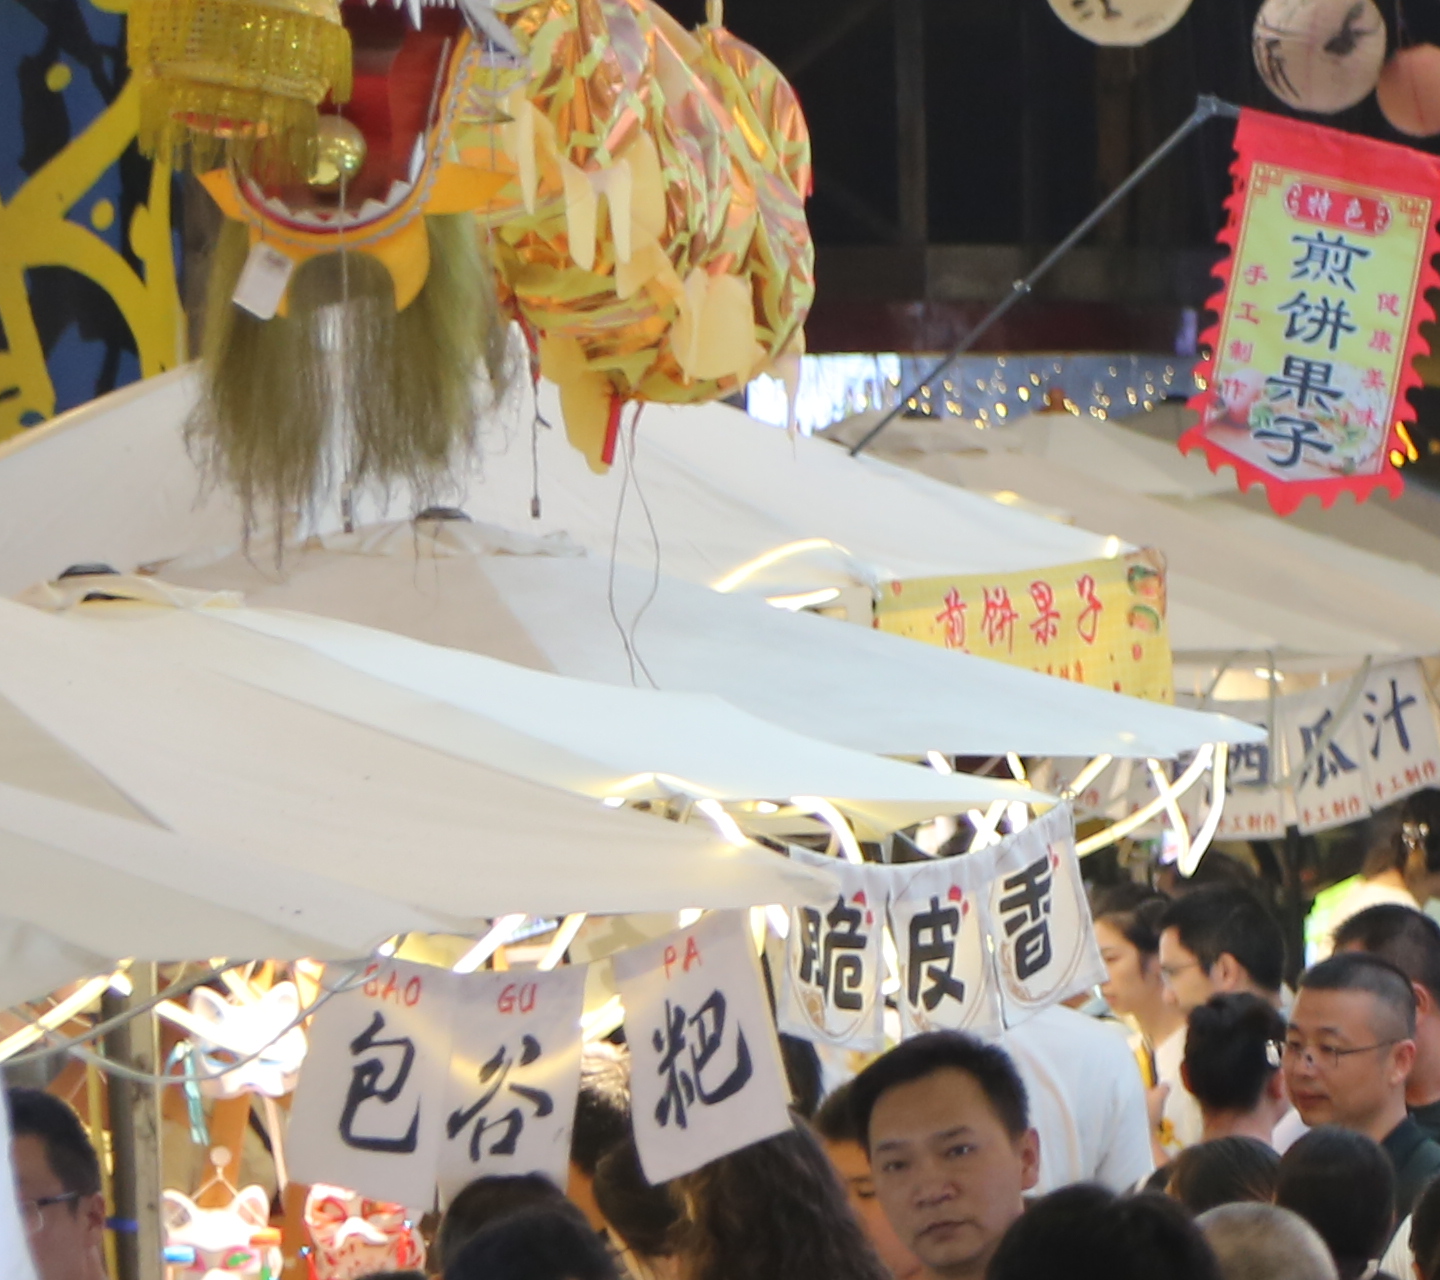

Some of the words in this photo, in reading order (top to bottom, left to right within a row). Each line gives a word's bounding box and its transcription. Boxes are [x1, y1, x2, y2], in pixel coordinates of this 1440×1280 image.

[1306, 189, 1367, 230] 特色
[1220, 263, 1269, 403] 手工制作
[1253, 230, 1371, 470] 煎饼果子
[1353, 291, 1402, 430] 健康美味
[935, 573, 1103, 656] 煎饼果子
[497, 982, 539, 1015] GU
[663, 935, 704, 980] PA
[799, 852, 1054, 1012] 脆皮香
[339, 988, 754, 1163] 包谷粑
